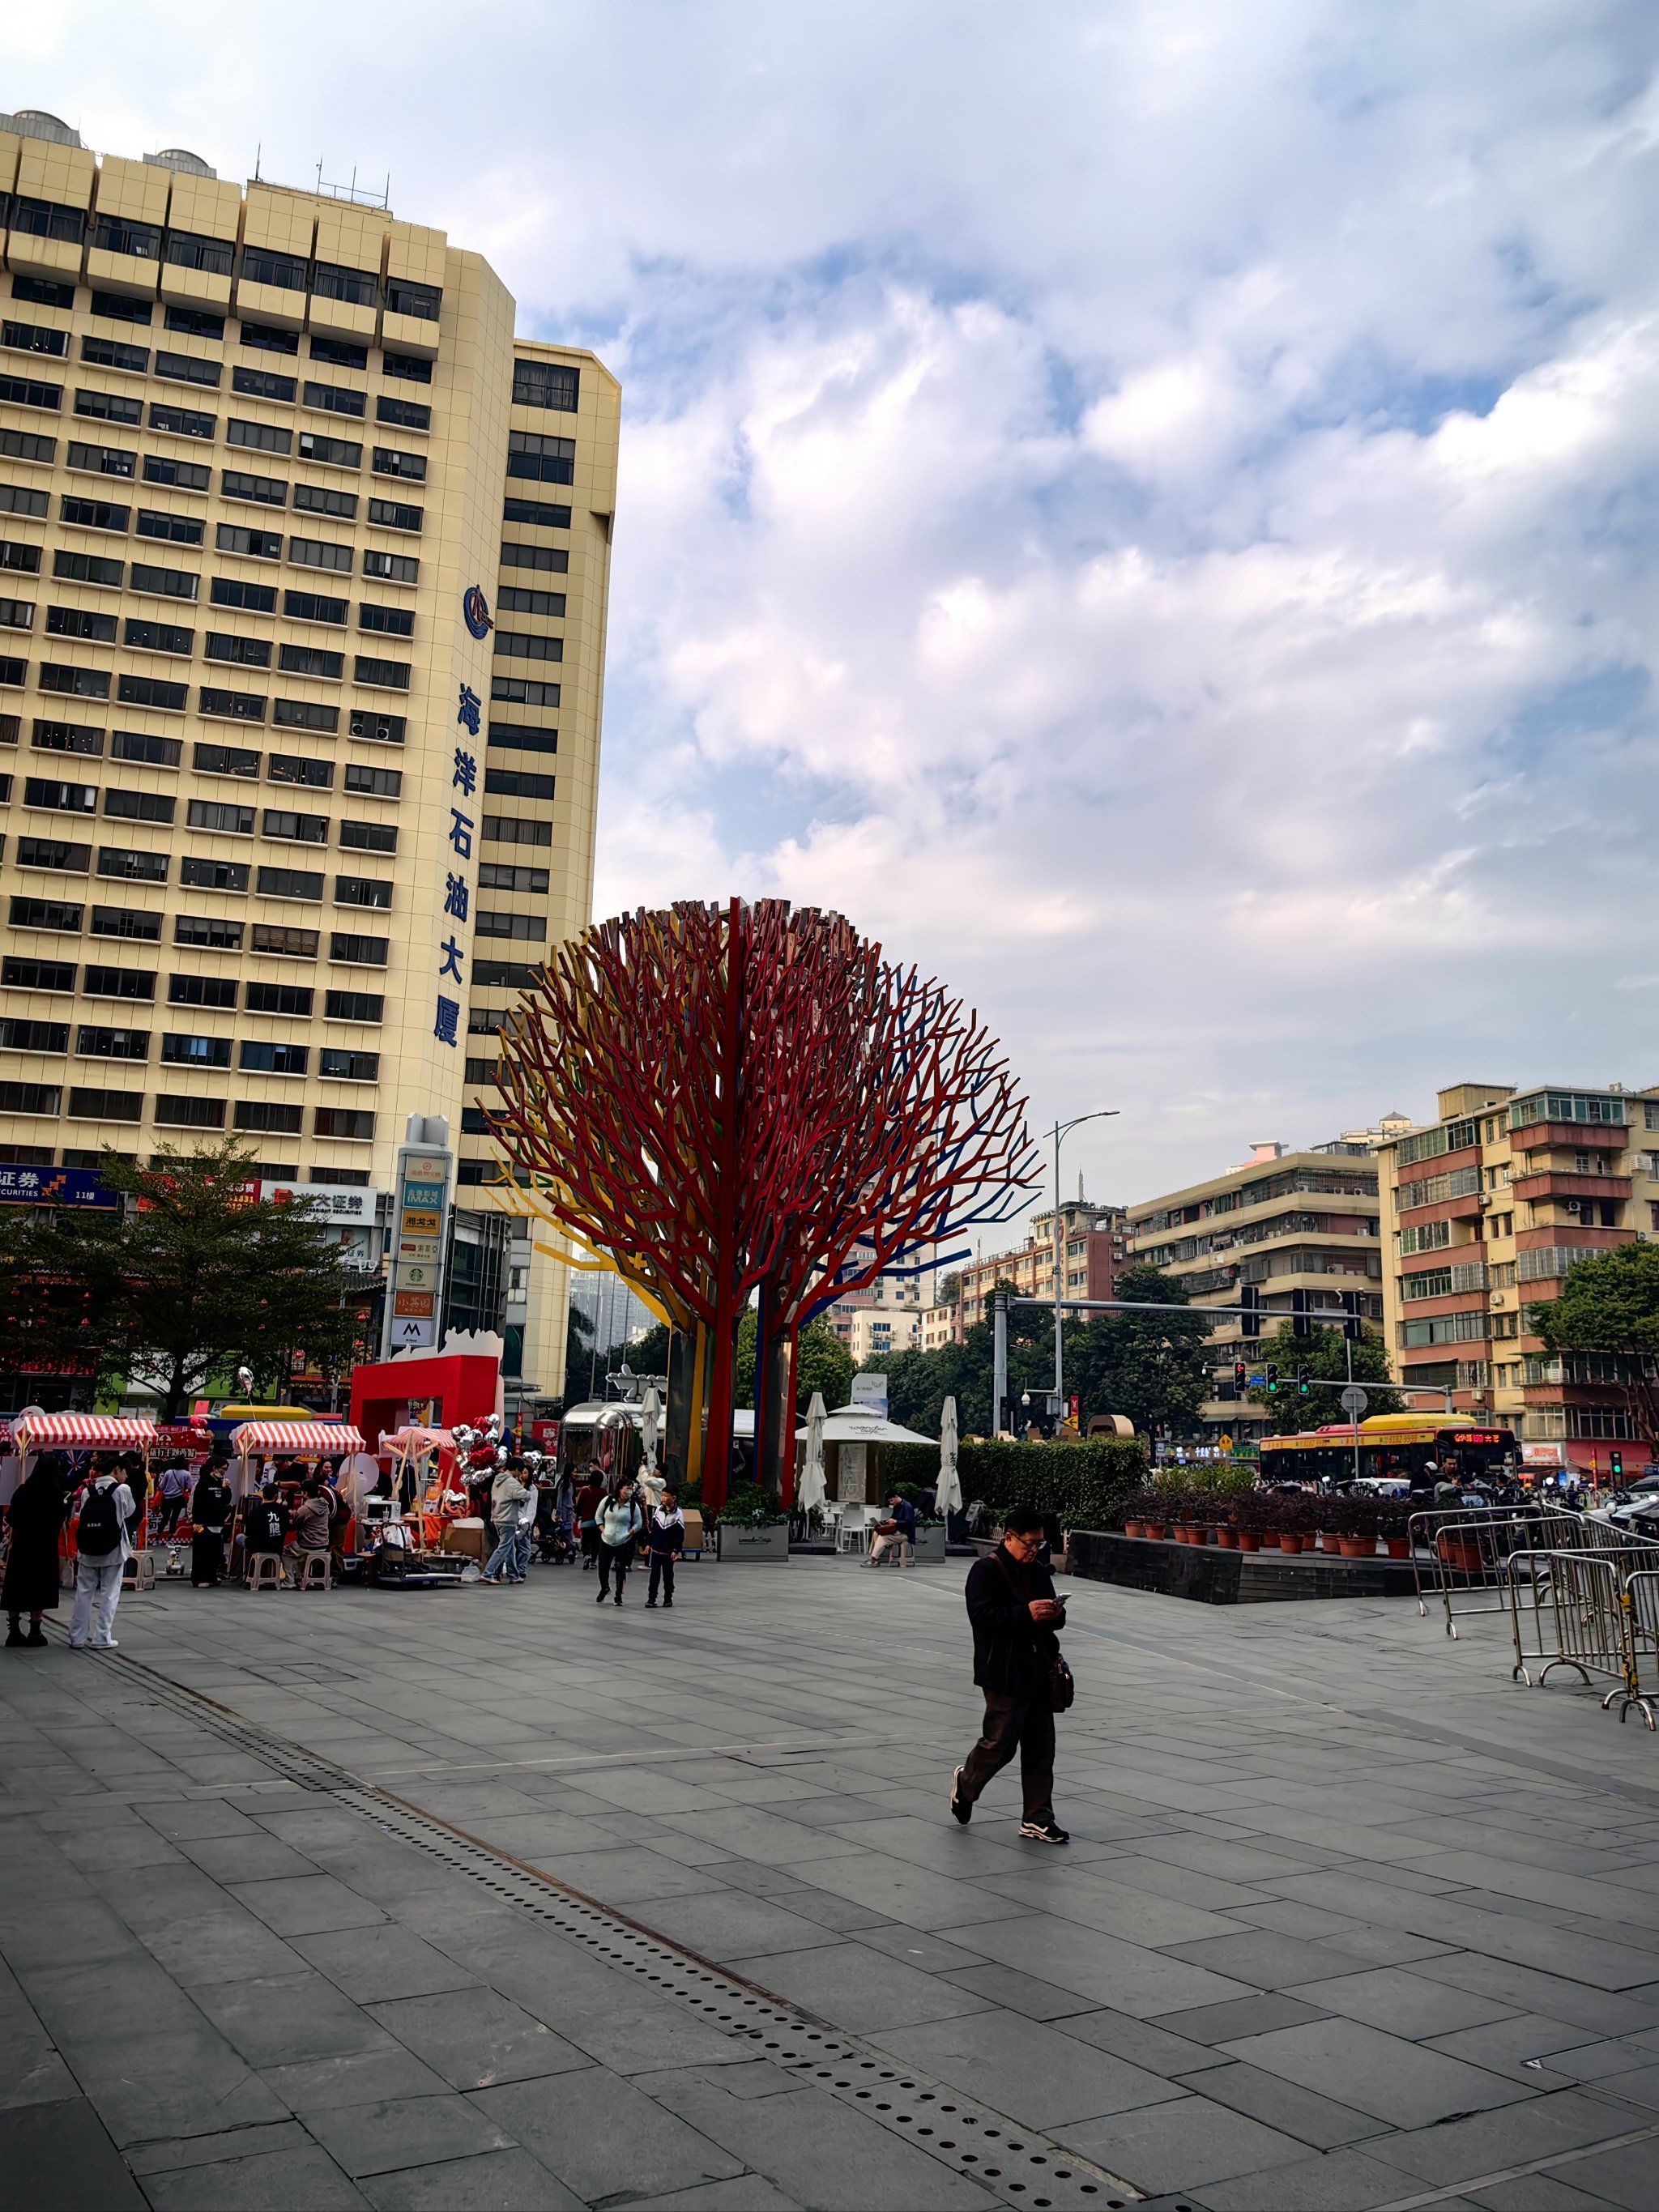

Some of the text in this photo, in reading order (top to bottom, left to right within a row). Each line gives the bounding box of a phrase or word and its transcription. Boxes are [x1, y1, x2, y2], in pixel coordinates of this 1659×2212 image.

[434, 683, 481, 1048] 海洋石油大厦
[0, 1171, 39, 1188] 证券
[0, 1188, 38, 1197] CURITIES
[75, 1191, 95, 1200] 11楼
[407, 1196, 437, 1204] IMAX
